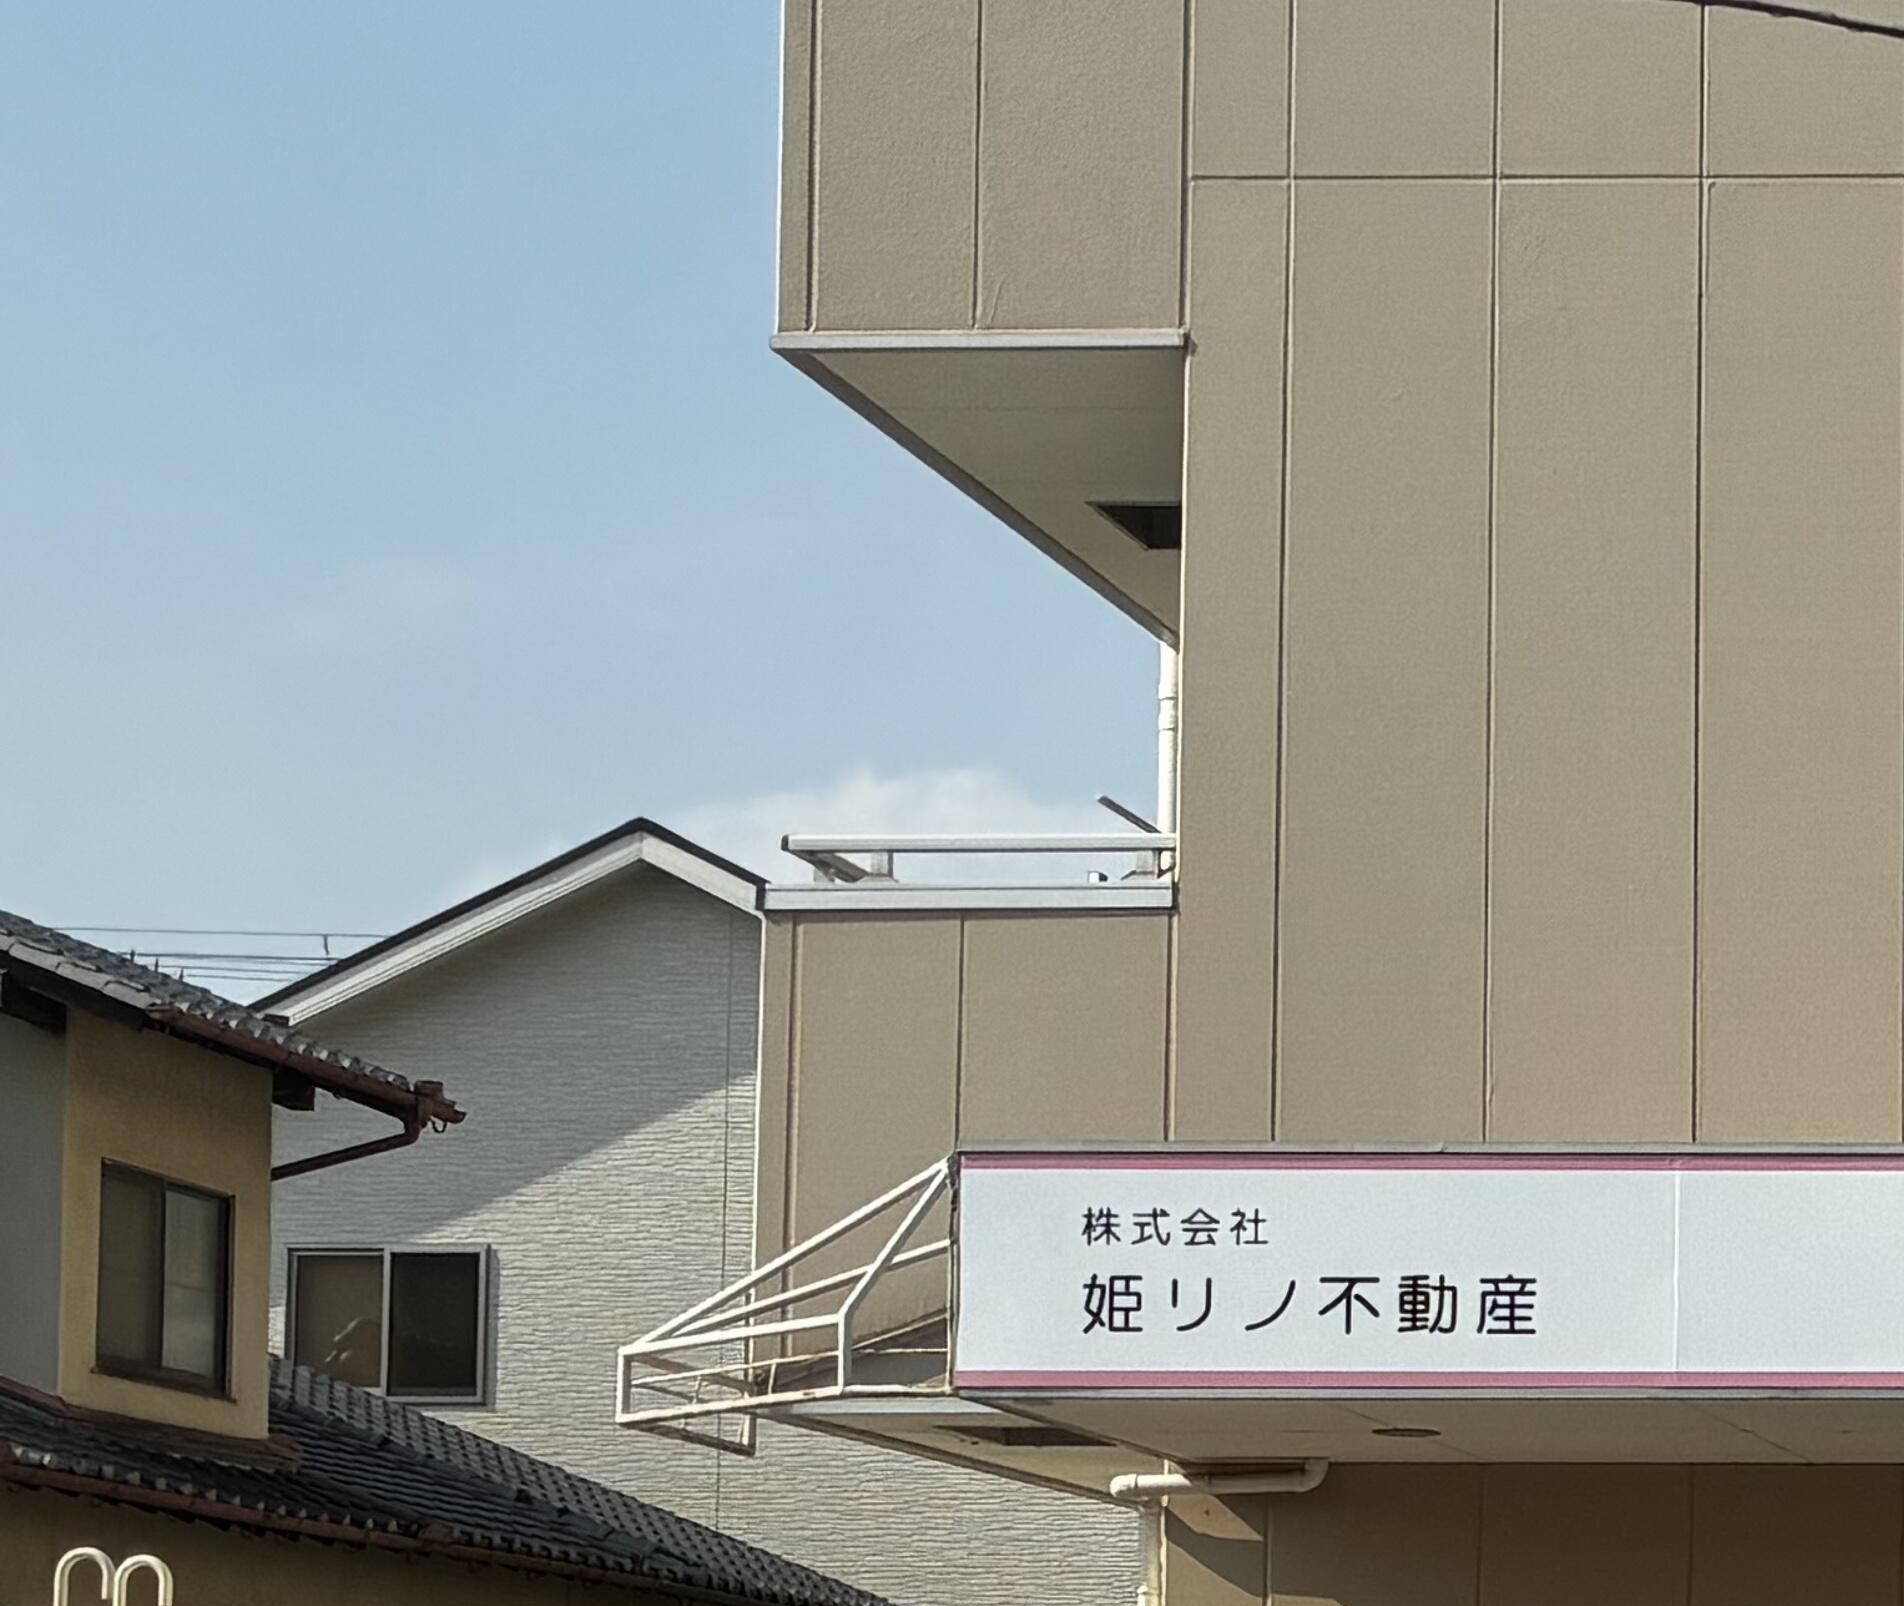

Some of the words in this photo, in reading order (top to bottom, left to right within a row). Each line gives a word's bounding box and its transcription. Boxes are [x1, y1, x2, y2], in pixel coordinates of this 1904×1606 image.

[1080, 1207, 1270, 1247] 株式会社
[1082, 1273, 1538, 1335] 姫リノ不動産
